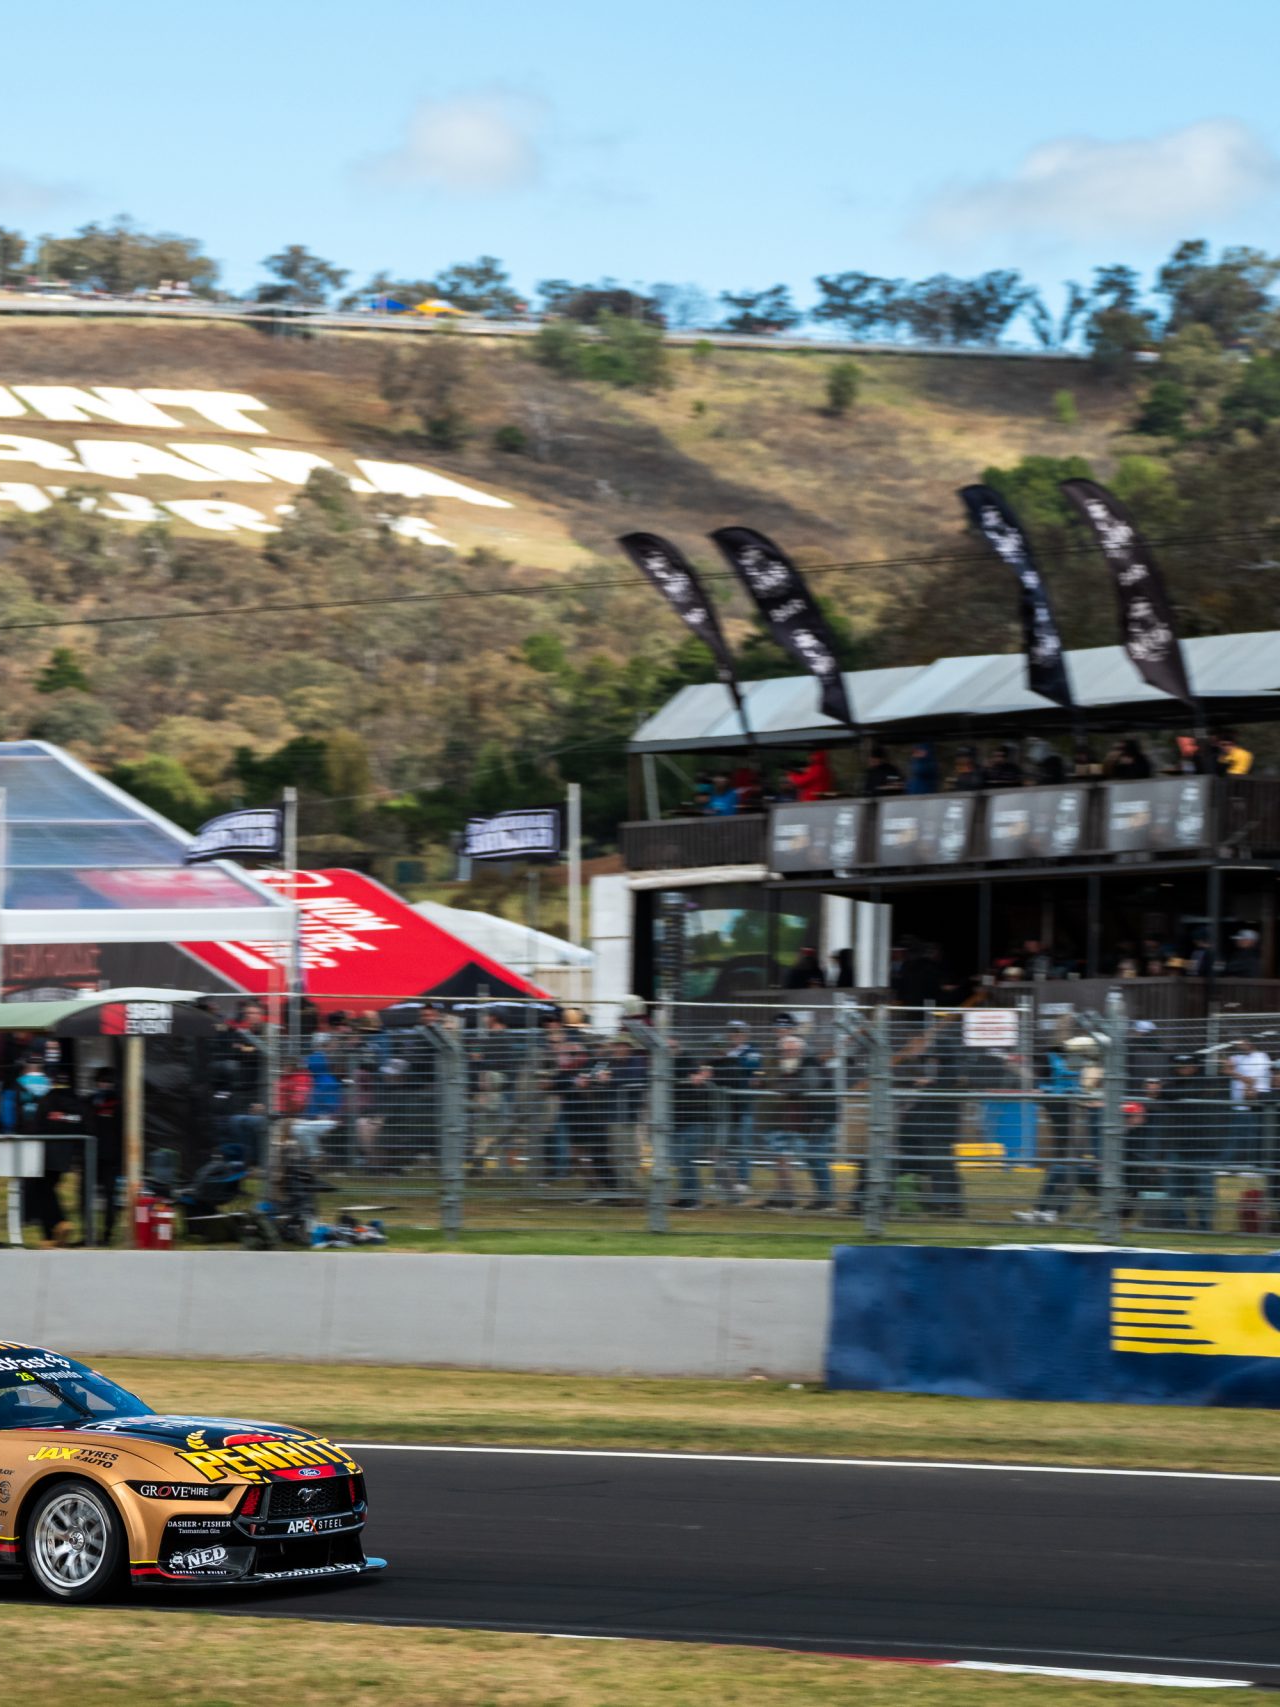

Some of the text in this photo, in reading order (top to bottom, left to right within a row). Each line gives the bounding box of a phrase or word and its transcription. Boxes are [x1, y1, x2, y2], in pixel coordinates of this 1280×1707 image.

[16, 1371, 35, 1382] 26
[28, 1446, 120, 1462] JAX TYRES
[80, 1456, 114, 1469] AUTO
[140, 1484, 209, 1498] GROVE HIRE
[167, 1520, 232, 1528] DASHER FISHER
[287, 1517, 343, 1535] APEX STEEL
[187, 1546, 226, 1568] NED
